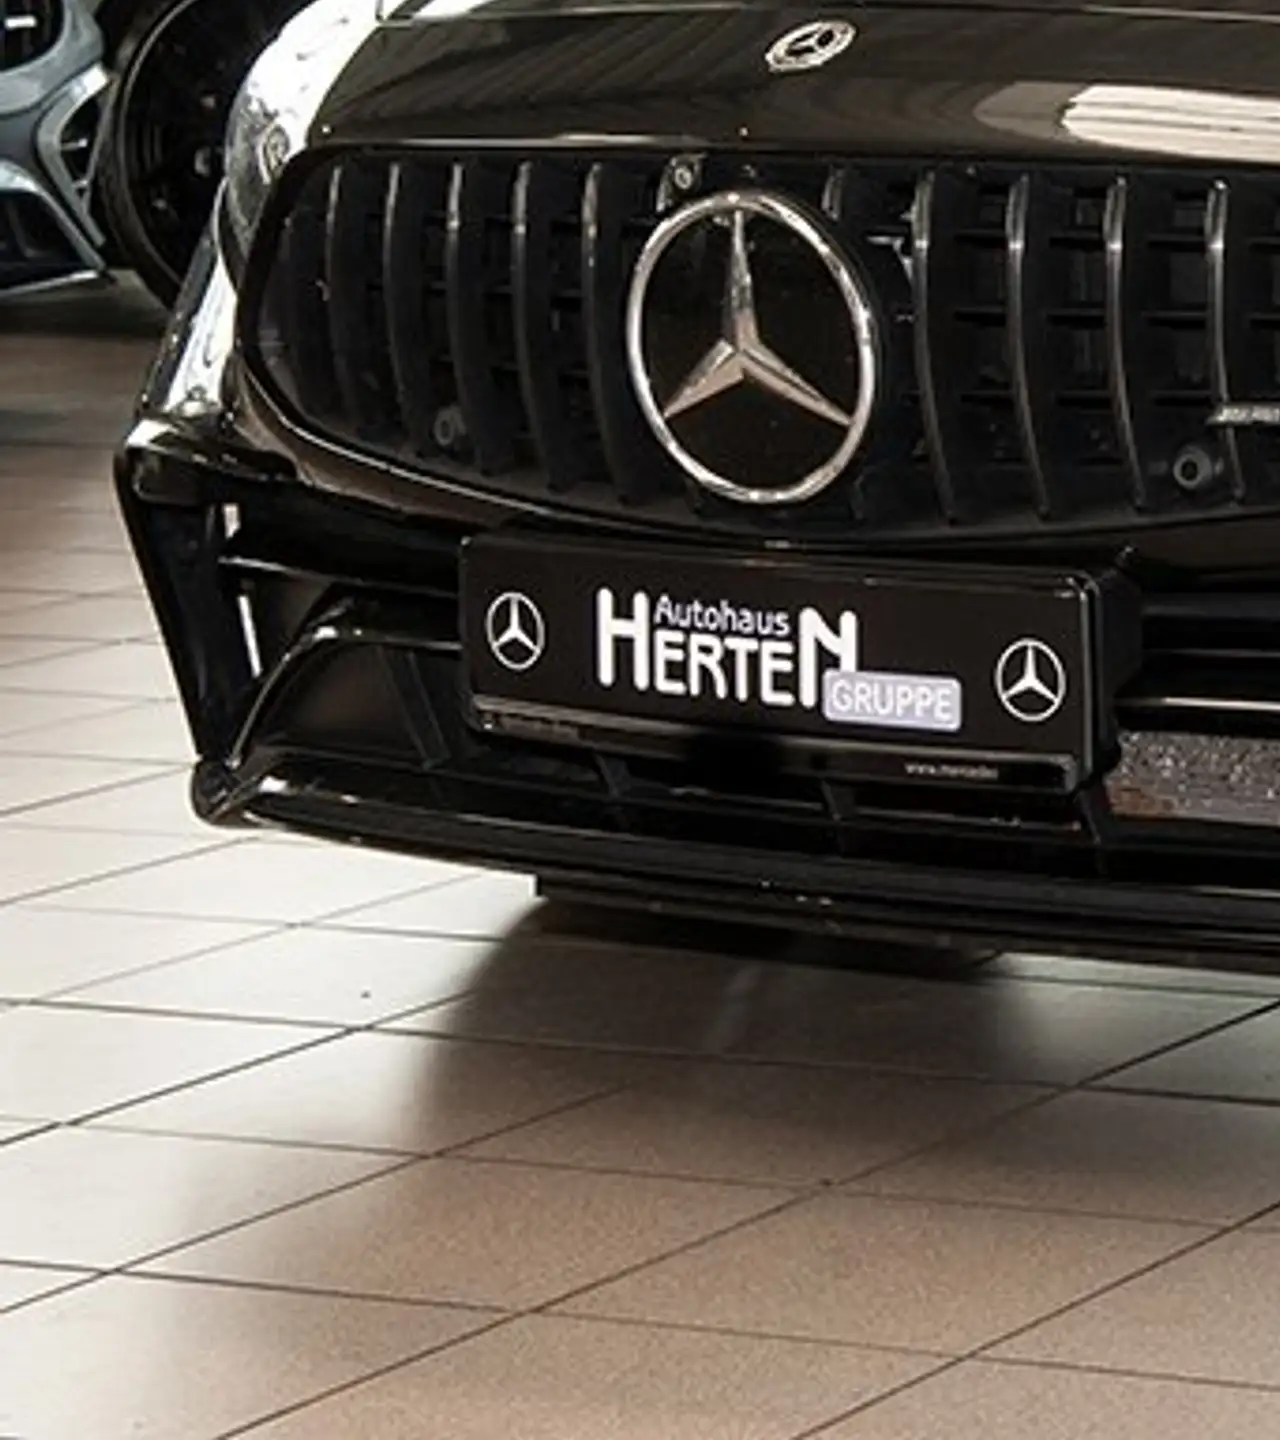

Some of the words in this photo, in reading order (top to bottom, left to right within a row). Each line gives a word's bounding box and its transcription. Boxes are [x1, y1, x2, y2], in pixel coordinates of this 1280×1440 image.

[654, 593, 790, 636] Autohaus
[597, 587, 859, 709] HERTEN
[831, 677, 953, 723] GRUPPE
